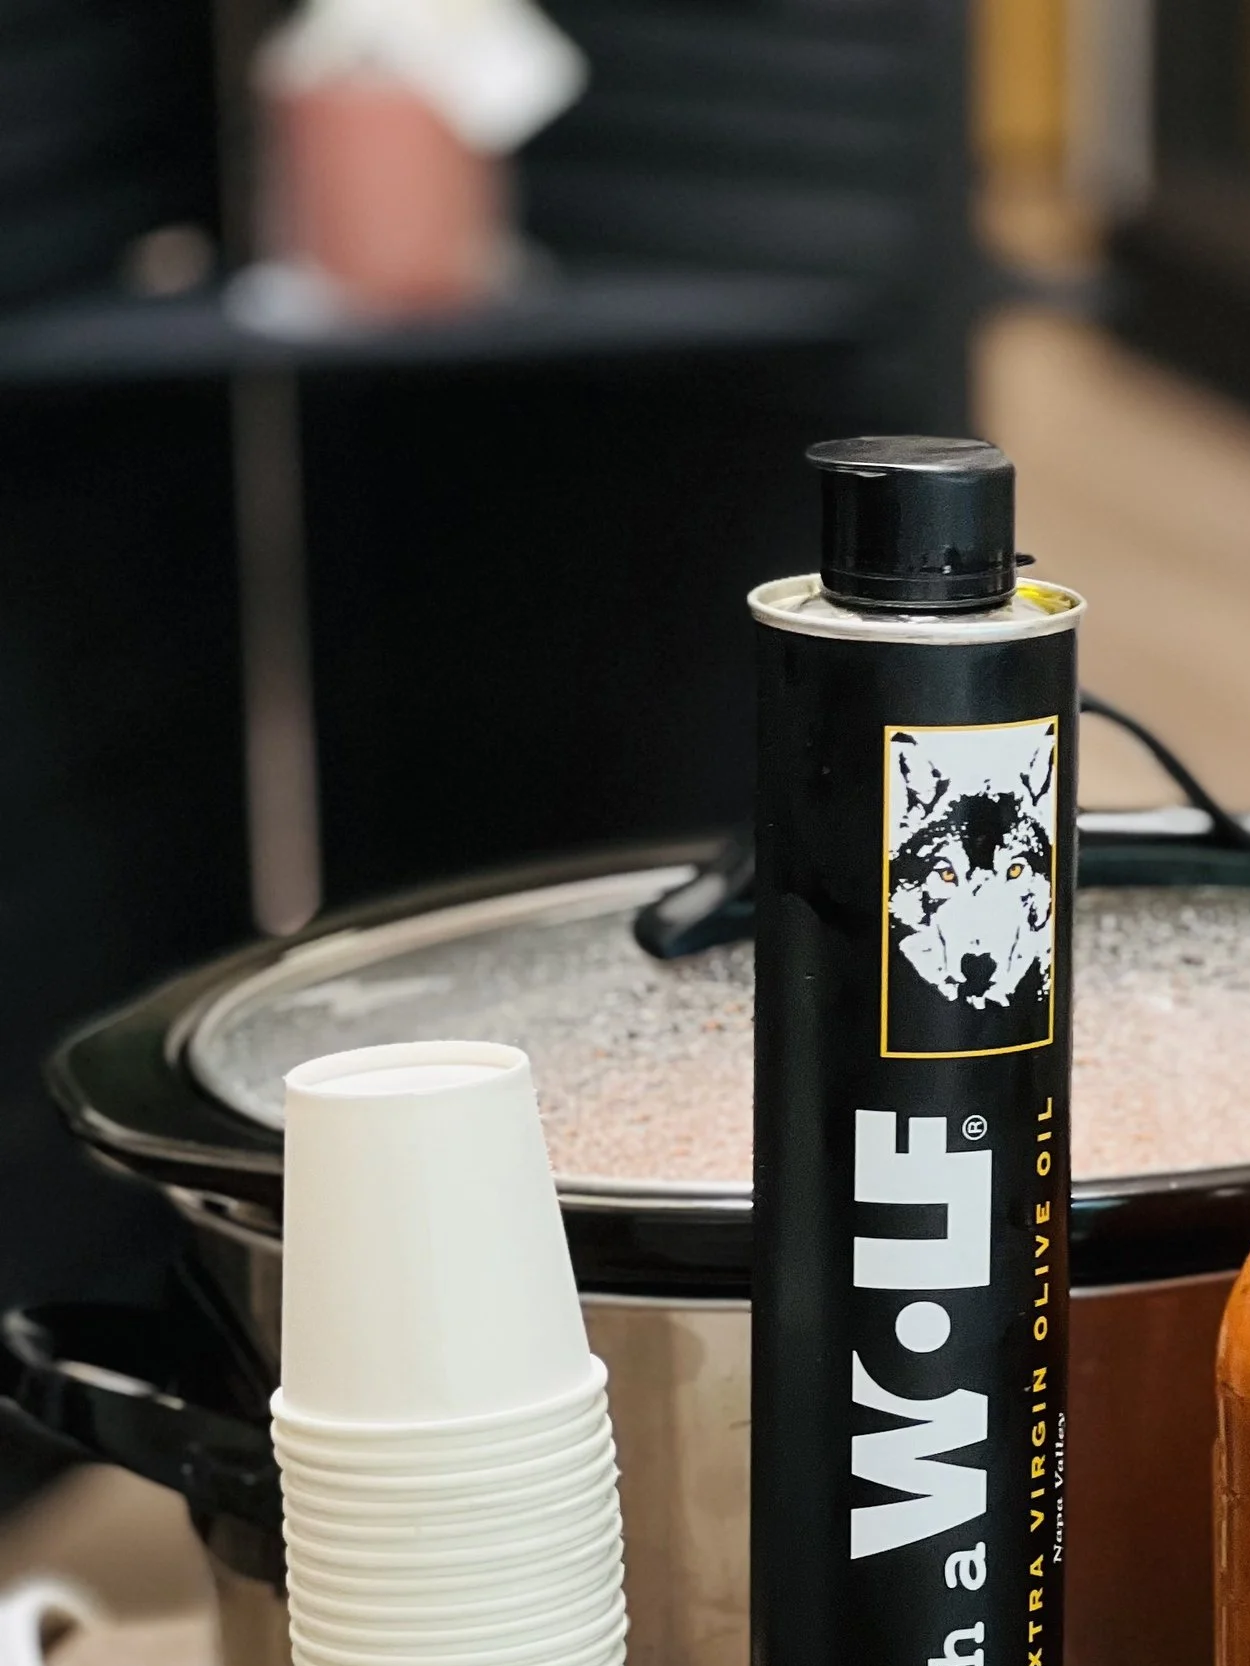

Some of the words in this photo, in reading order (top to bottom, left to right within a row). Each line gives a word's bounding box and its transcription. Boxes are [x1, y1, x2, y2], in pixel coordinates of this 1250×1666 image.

[1036, 1096, 1054, 1176] OIL
[1033, 1199, 1052, 1342] OLIVE
[1030, 1366, 1048, 1533] VIRGIN
[1054, 1412, 1066, 1489] Valley
[1053, 1496, 1064, 1564] Napa
